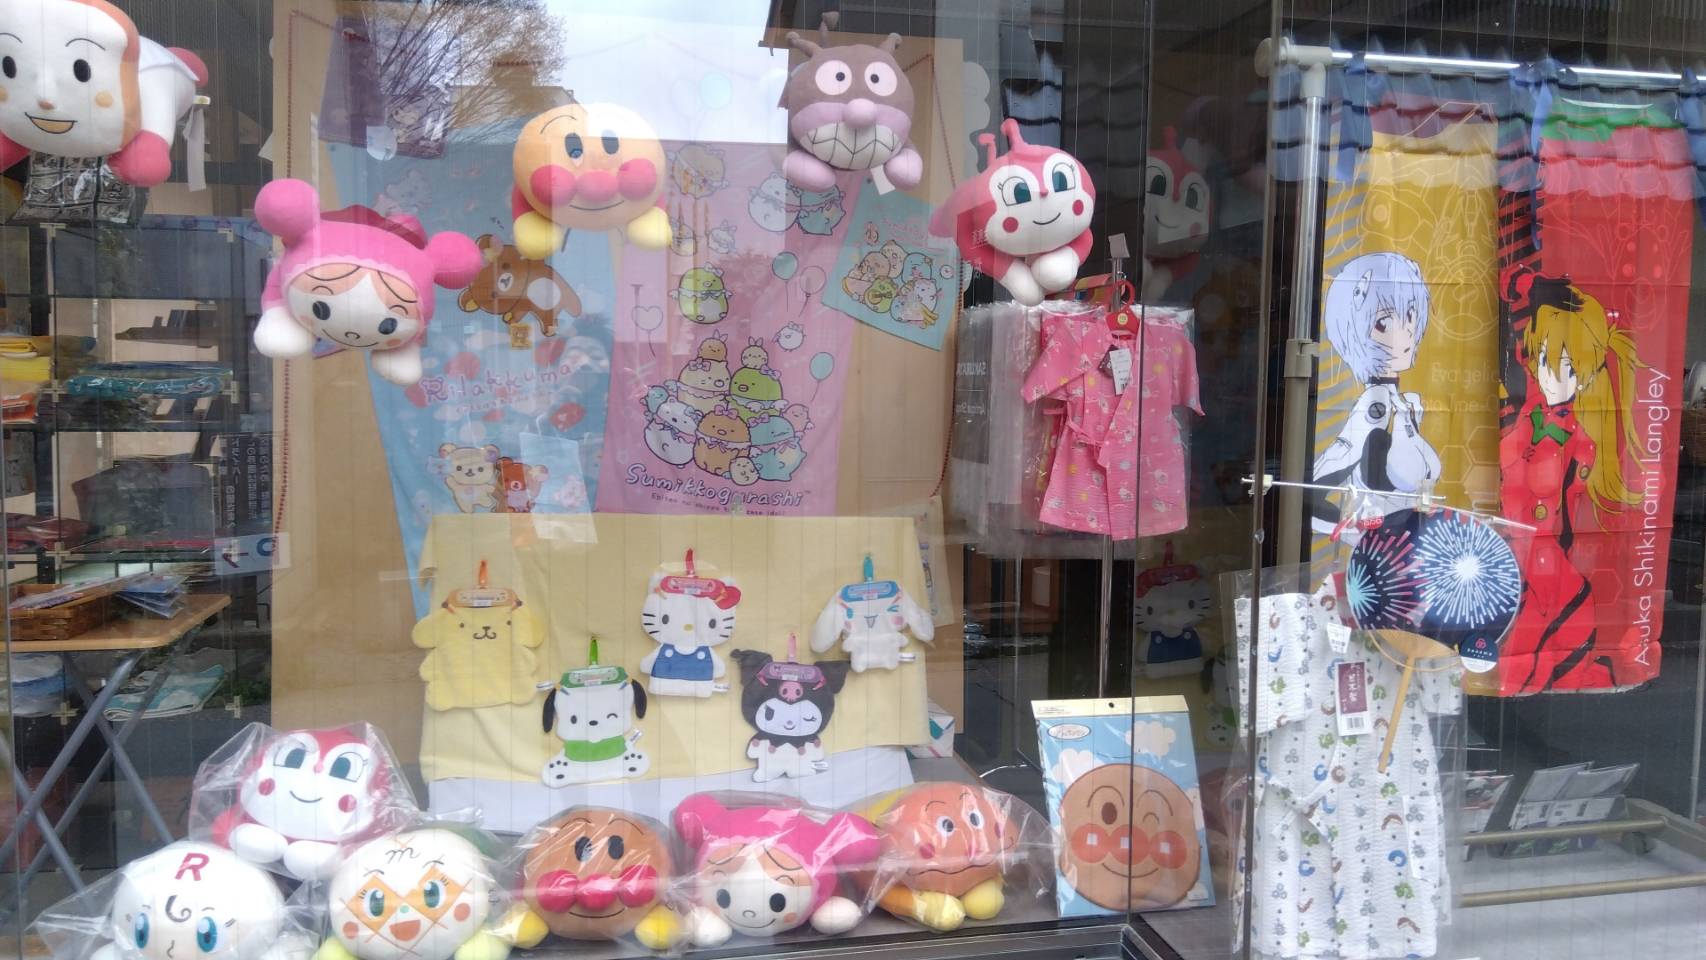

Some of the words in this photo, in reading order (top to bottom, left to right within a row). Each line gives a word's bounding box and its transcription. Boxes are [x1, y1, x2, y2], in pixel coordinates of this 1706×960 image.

[421, 363, 571, 402] Rilakkuma
[1638, 367, 1671, 462] Langley
[1633, 471, 1659, 587] Shikinami
[175, 852, 210, 882] R
